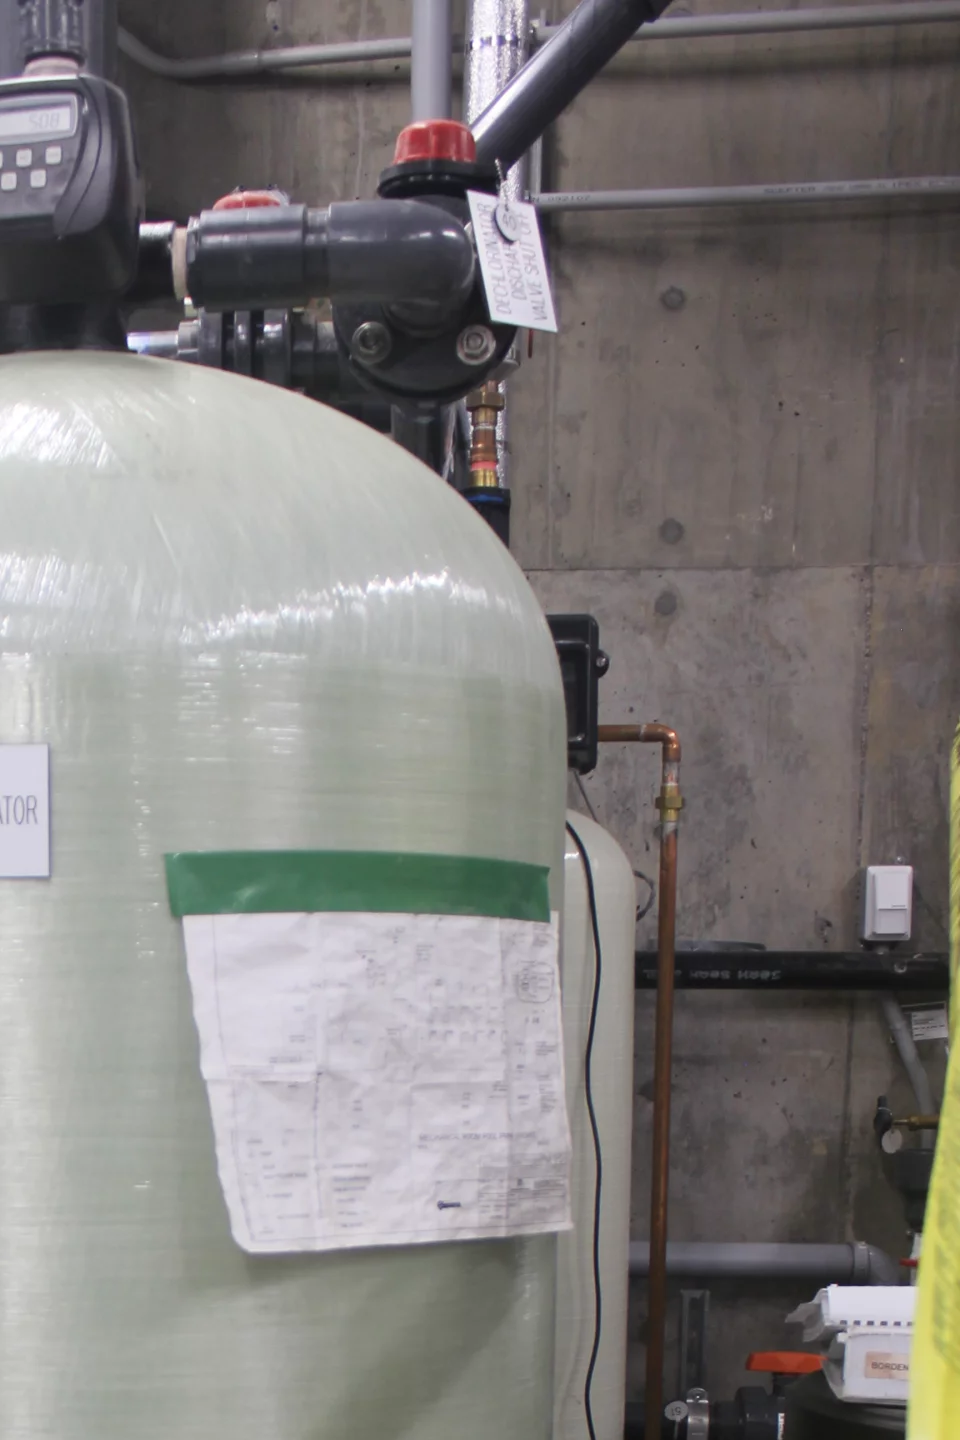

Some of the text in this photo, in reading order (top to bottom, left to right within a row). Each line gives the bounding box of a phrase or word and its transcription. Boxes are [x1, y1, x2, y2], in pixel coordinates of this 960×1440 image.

[477, 203, 512, 315] DECHLORINATOR
[501, 243, 528, 301] DISCHA
[521, 242, 541, 276] SHUT
[528, 281, 548, 321] VALVE
